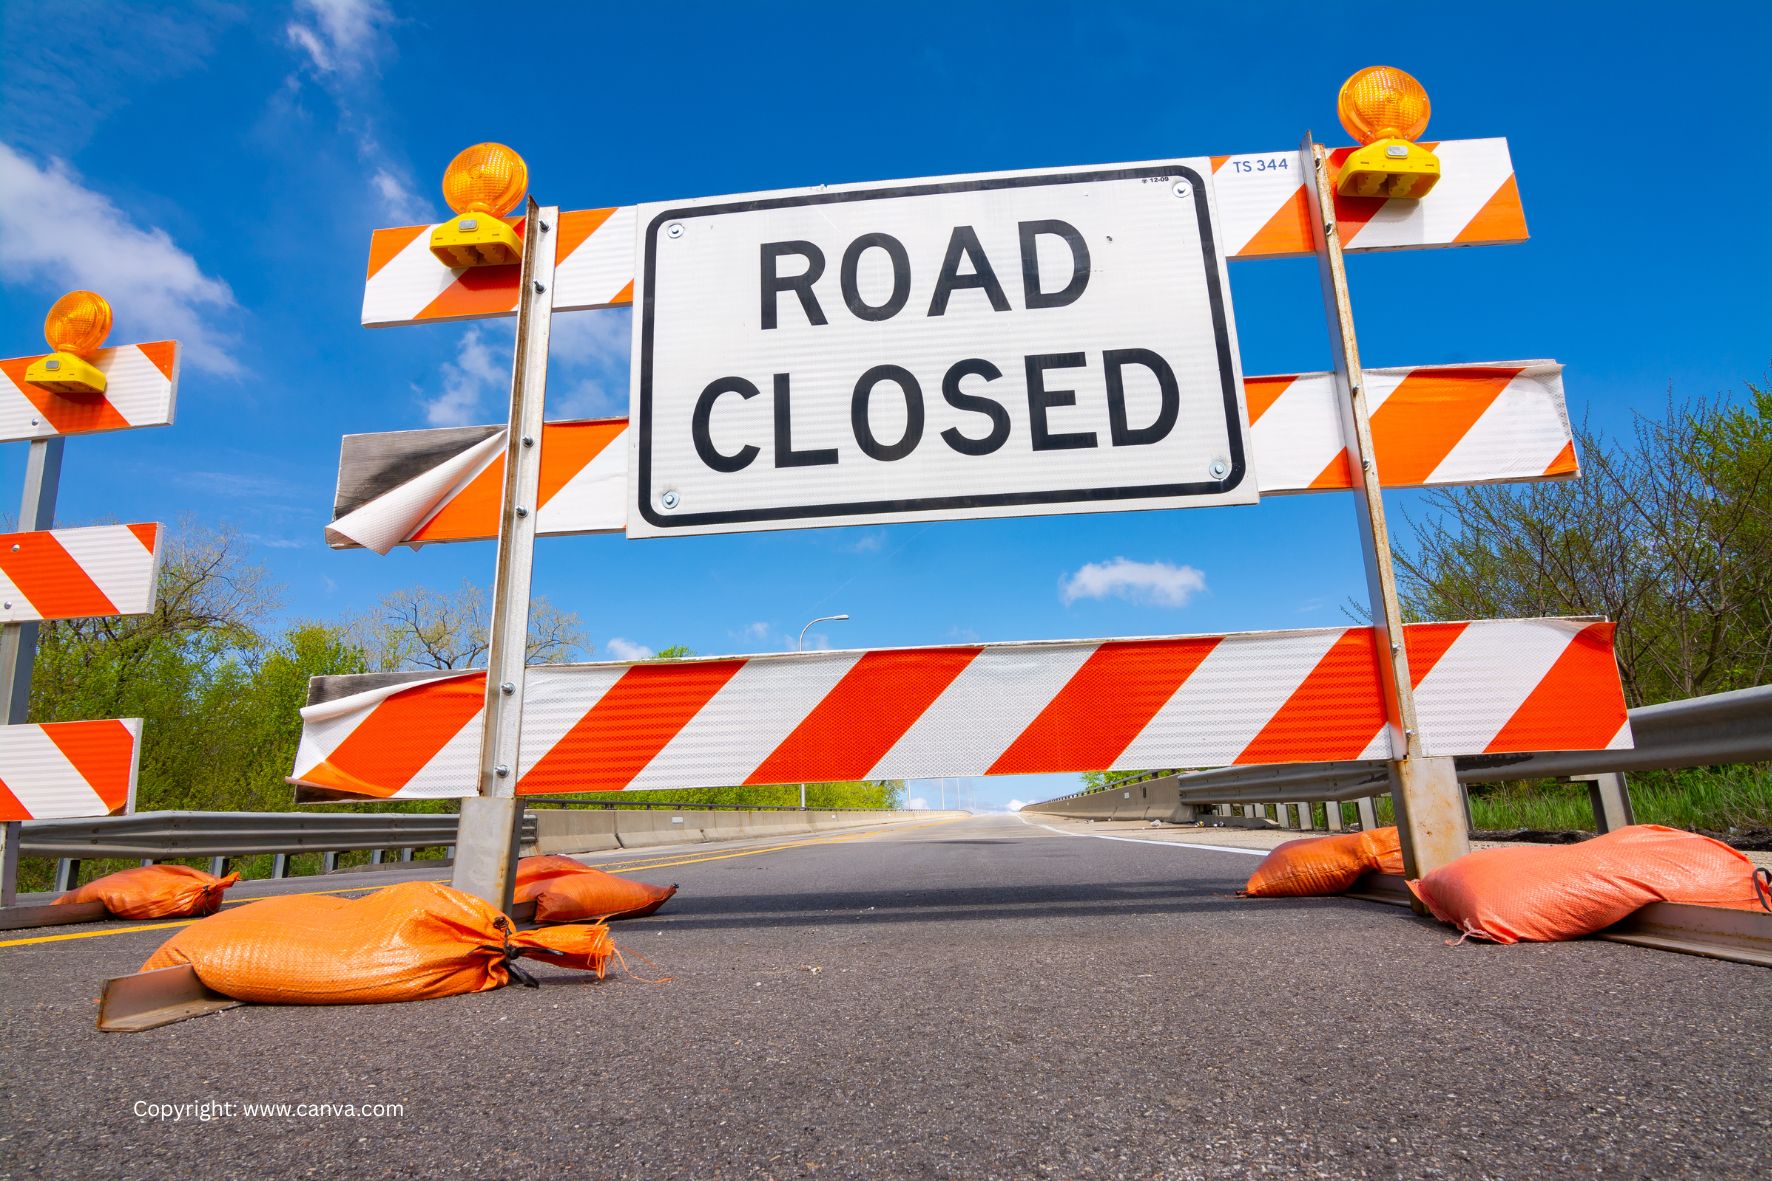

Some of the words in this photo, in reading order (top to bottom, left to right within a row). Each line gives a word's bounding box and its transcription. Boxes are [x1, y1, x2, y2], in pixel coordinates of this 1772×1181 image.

[1232, 160, 1252, 173] TS
[1256, 158, 1289, 172] 344
[760, 219, 1091, 330] ROAD
[691, 348, 1180, 473] CLOSED
